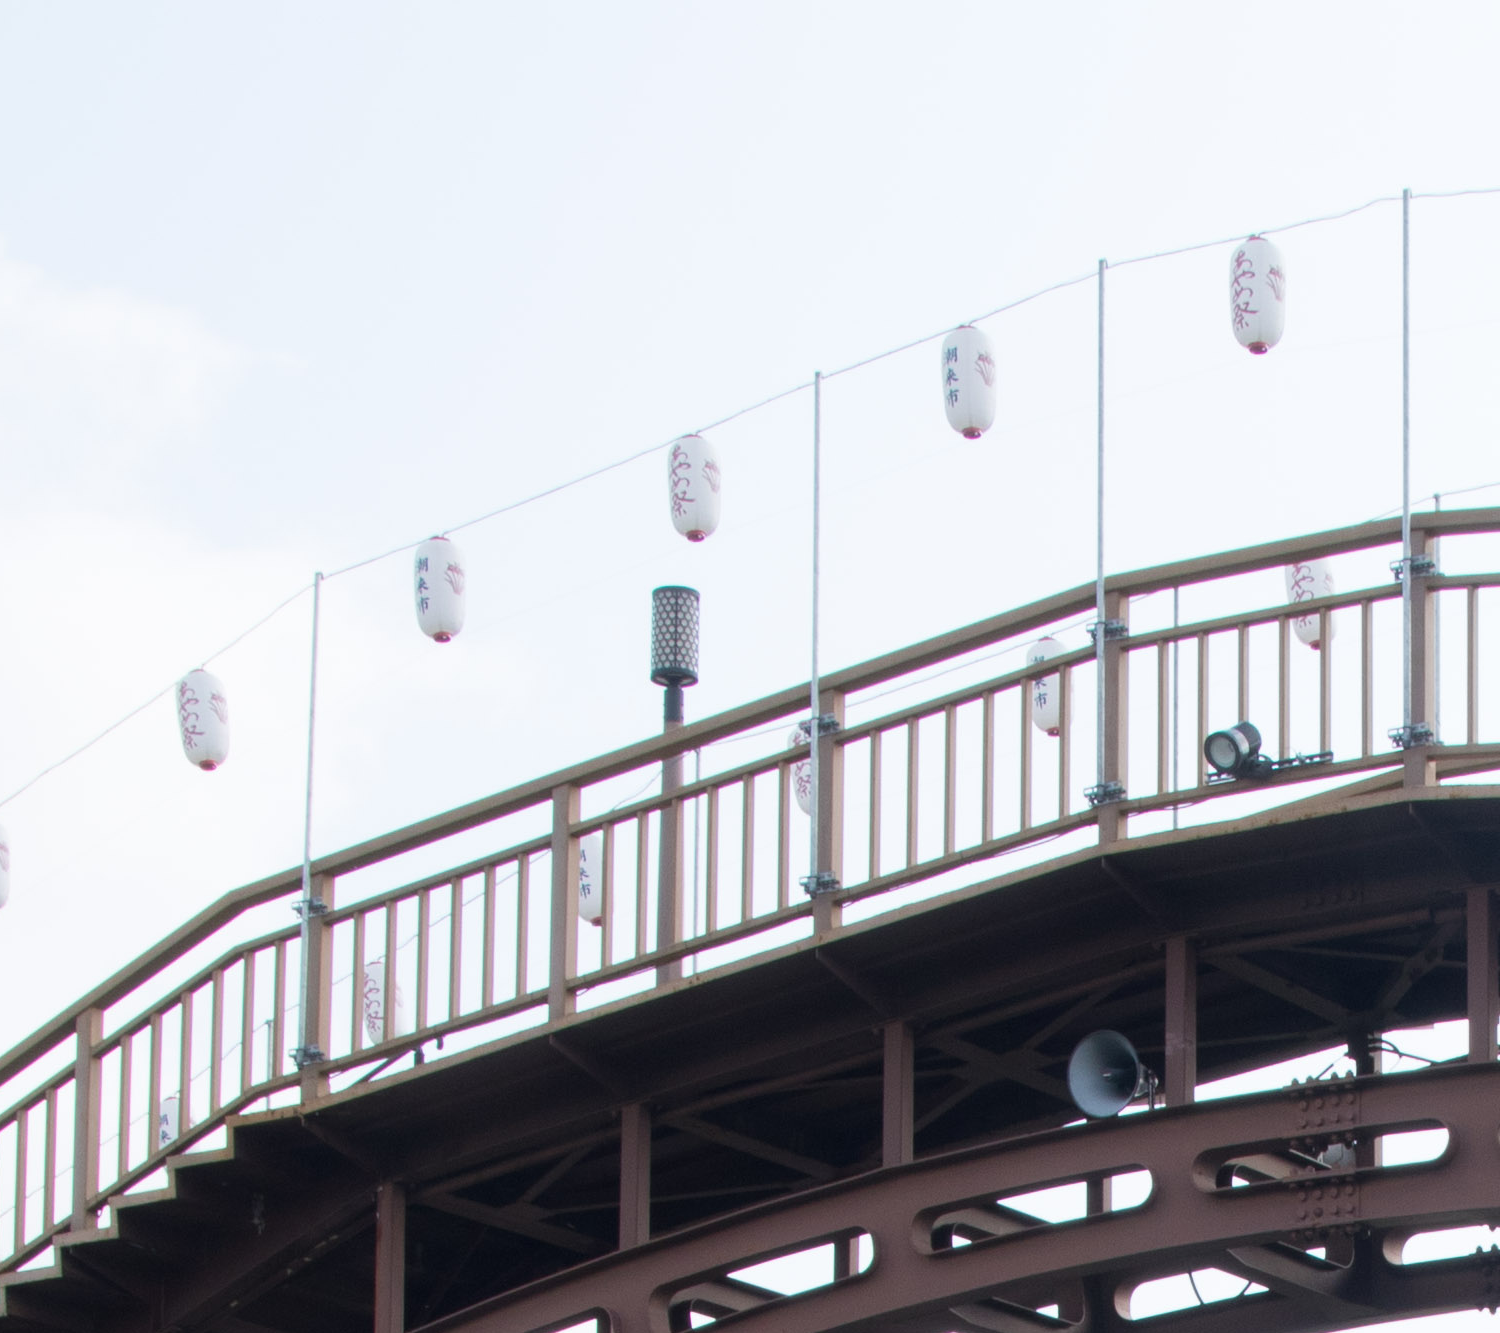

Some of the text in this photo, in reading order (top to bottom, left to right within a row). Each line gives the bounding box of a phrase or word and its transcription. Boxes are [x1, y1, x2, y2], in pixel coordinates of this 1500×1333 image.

[1231, 255, 1258, 332] あやめ祭
[670, 446, 695, 518] あやめ祭
